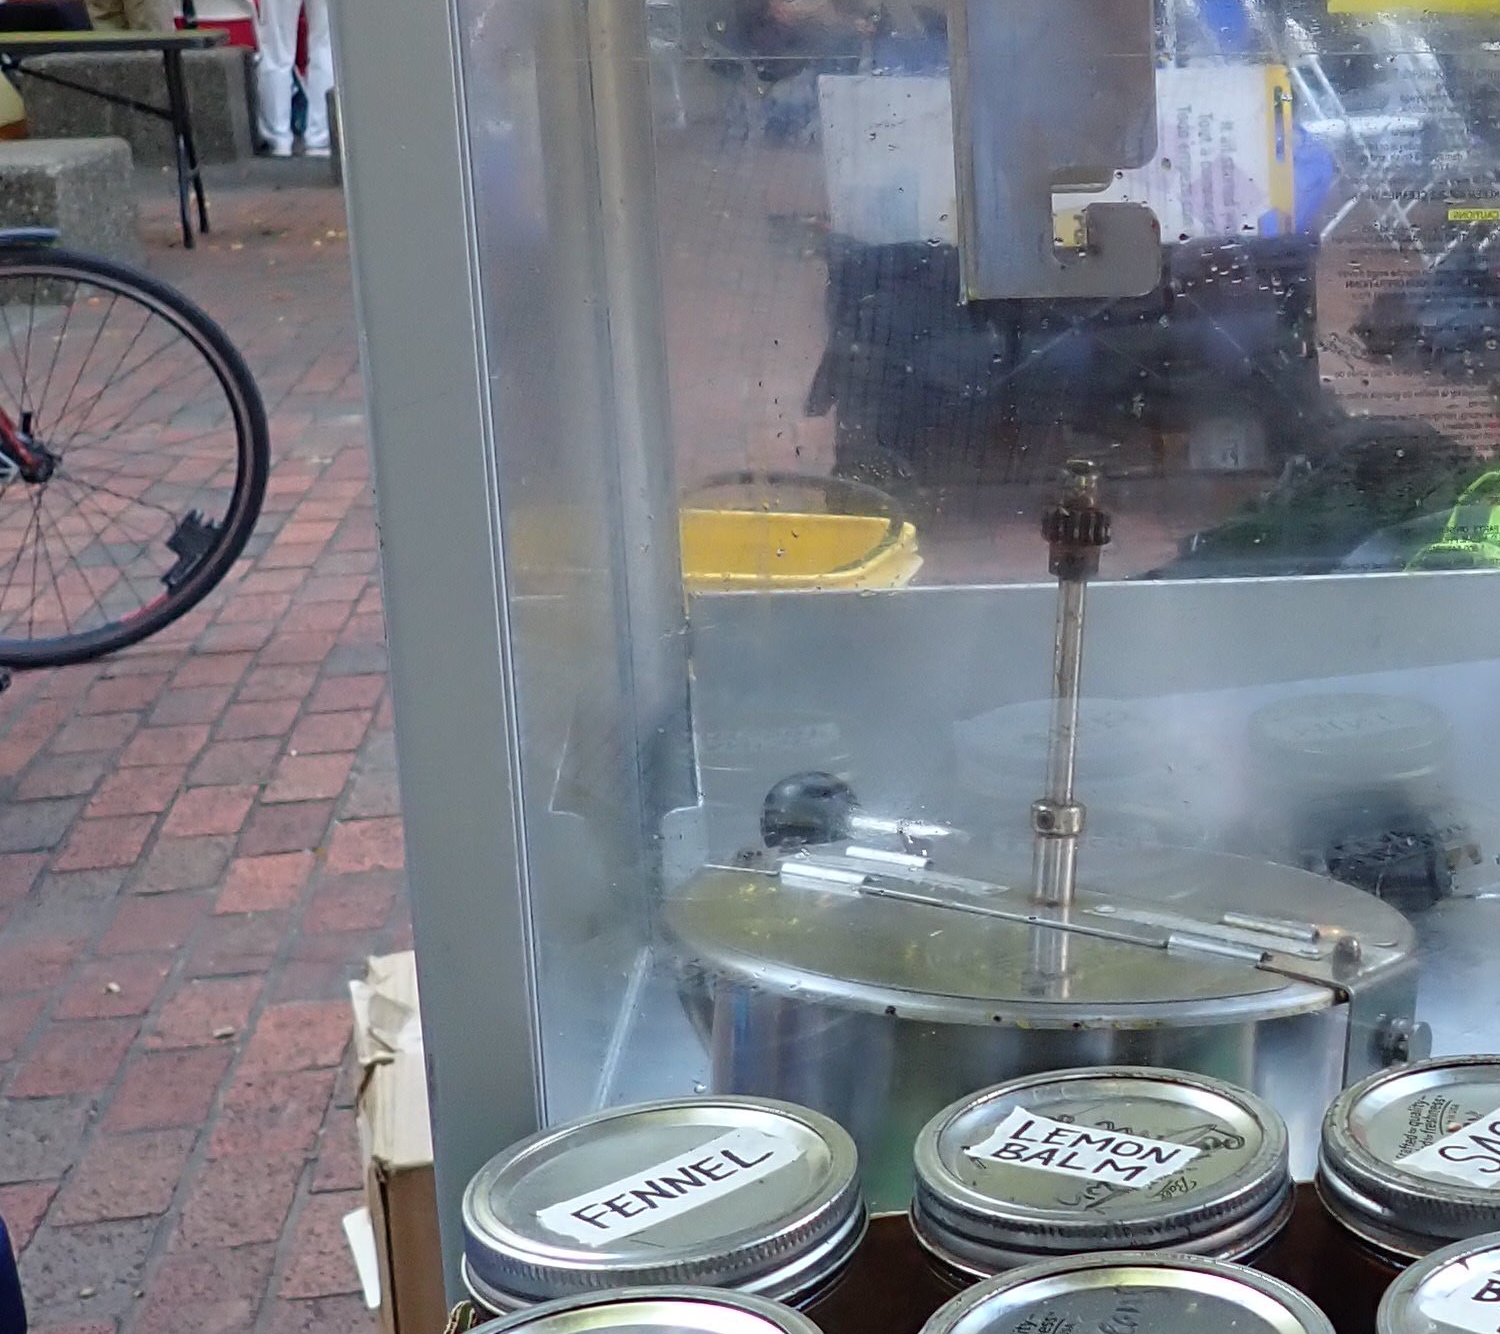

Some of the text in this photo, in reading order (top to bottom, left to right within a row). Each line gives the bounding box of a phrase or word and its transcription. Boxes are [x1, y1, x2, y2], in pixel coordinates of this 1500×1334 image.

[992, 1141, 1148, 1181] BALM
[1010, 1120, 1182, 1166] LEMON
[571, 1146, 775, 1230] FENNEL
